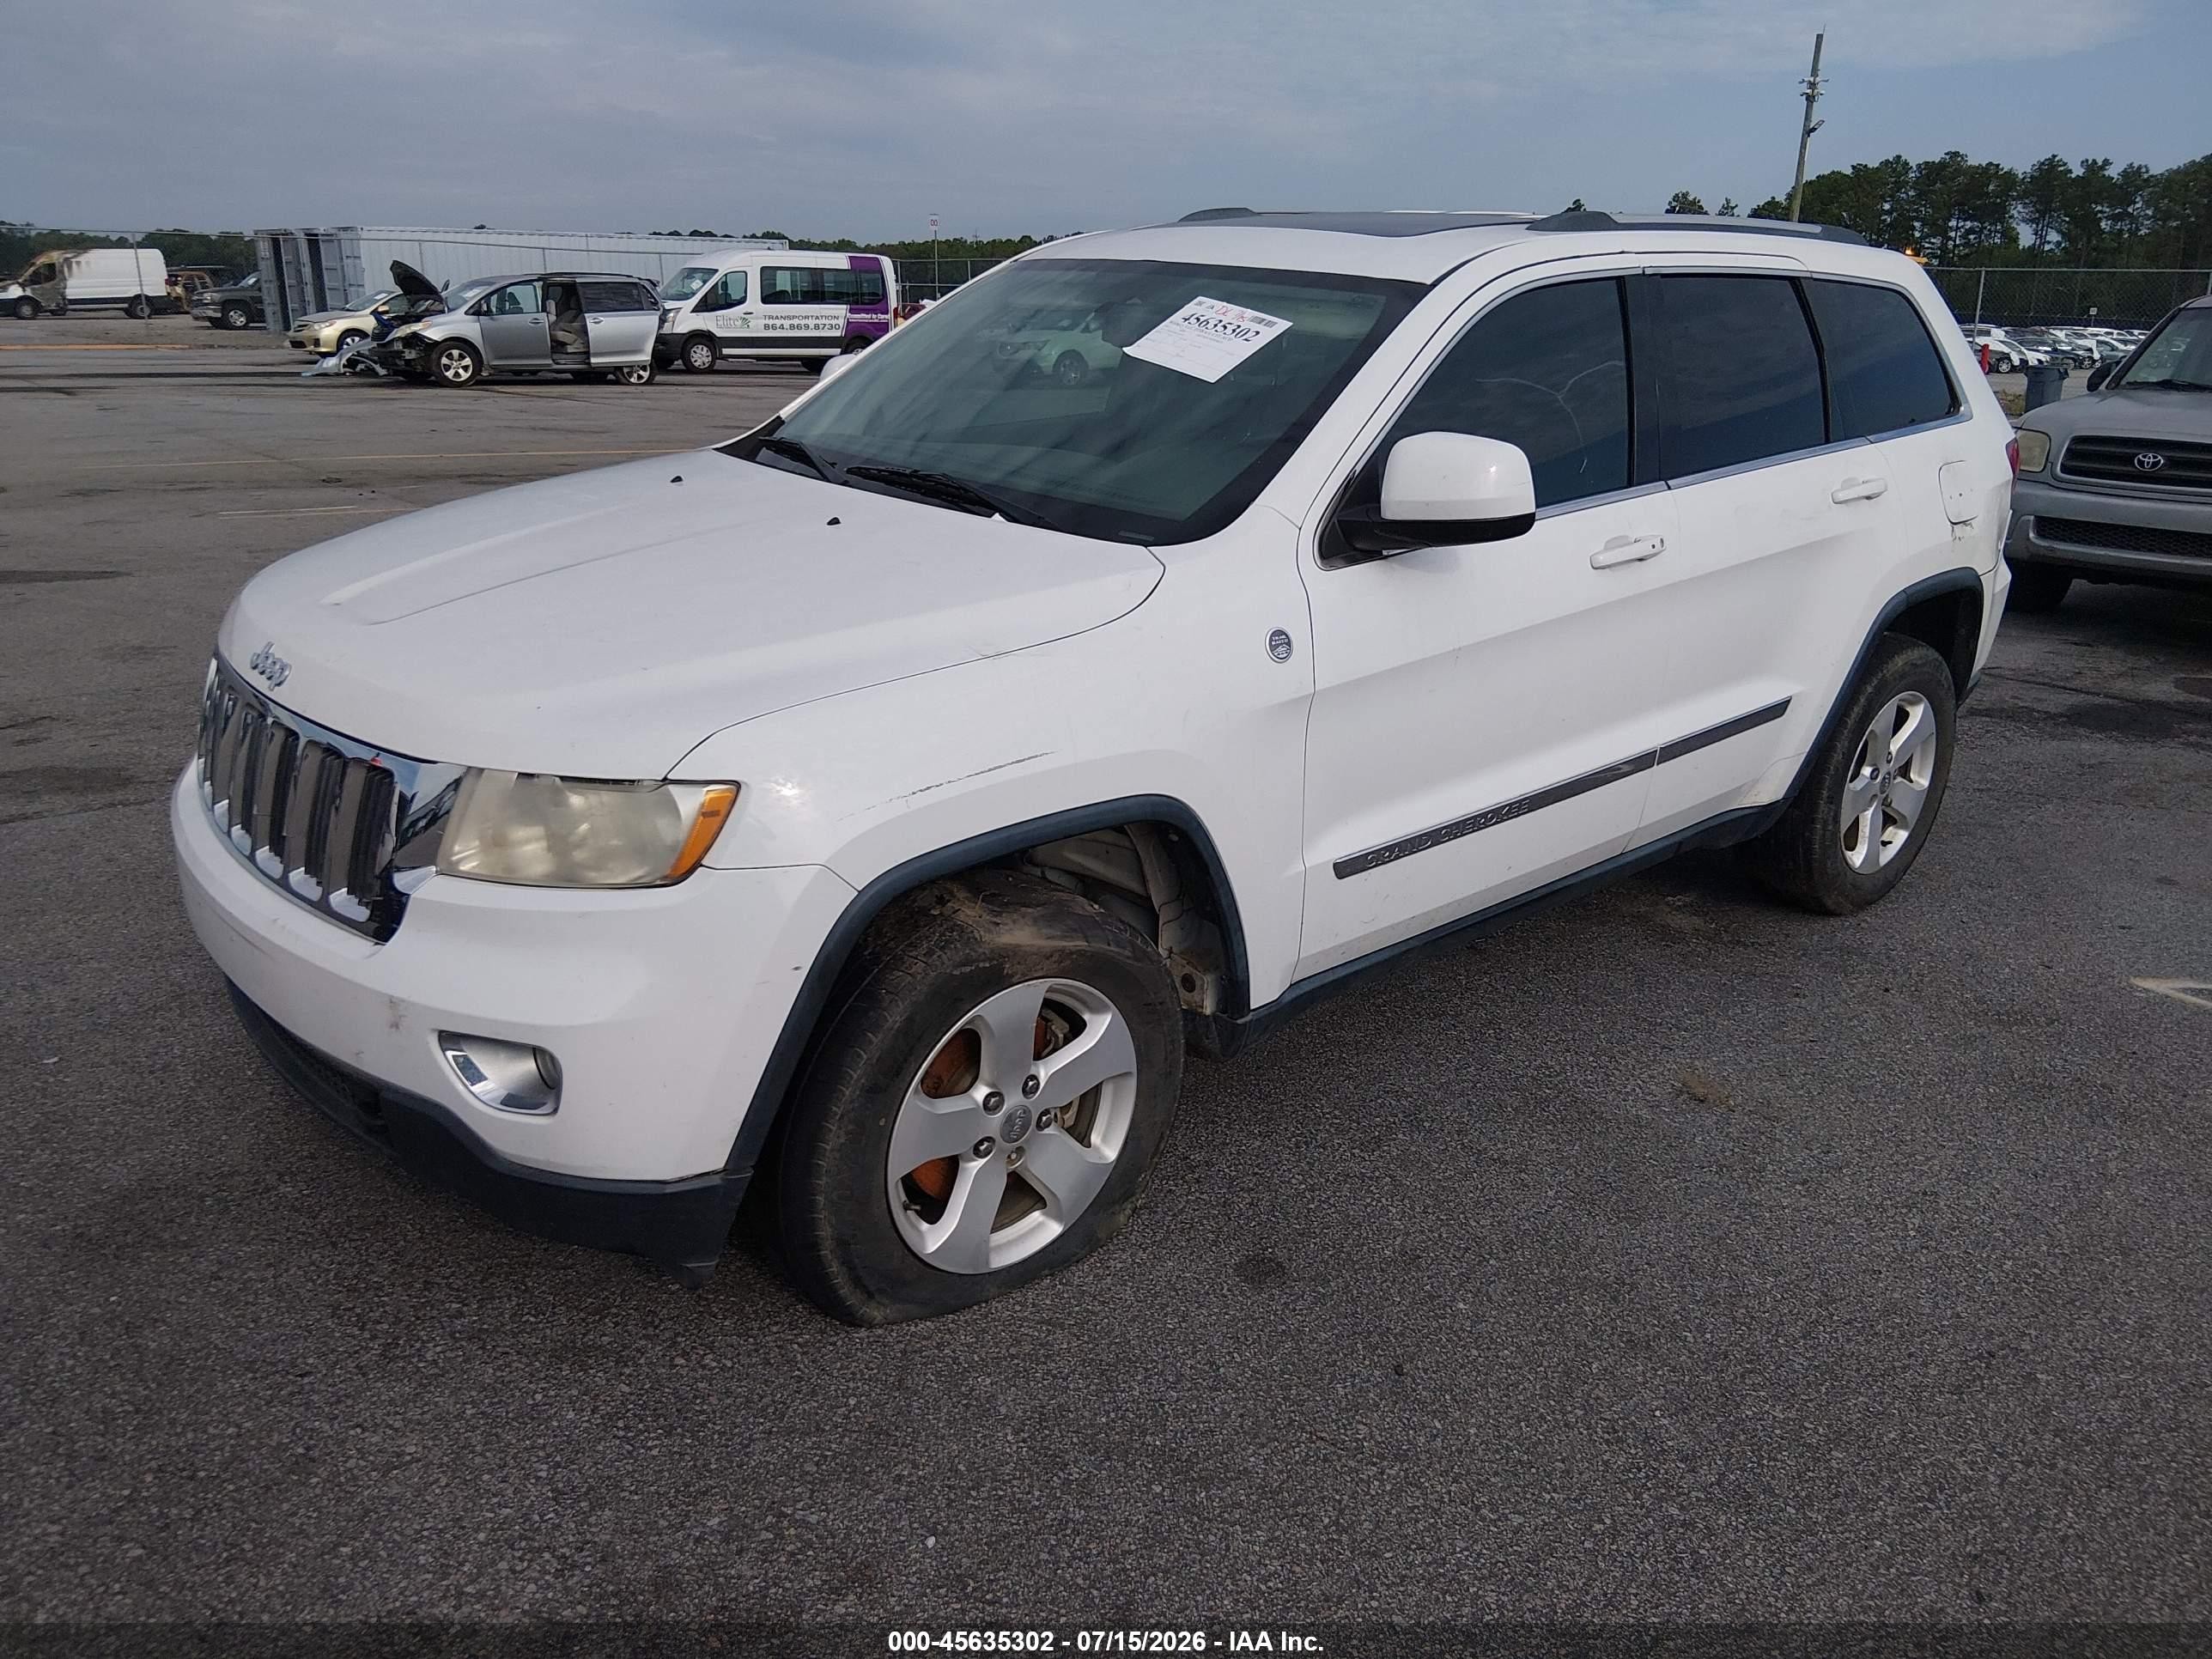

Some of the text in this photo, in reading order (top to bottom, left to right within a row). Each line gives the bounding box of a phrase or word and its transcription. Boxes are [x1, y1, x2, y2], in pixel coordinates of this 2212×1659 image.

[715, 315, 739, 327] Elite
[1181, 313, 1261, 342] 45635302
[250, 641, 292, 691] Jeep
[1366, 799, 1530, 867] GRAND CHEROKEE
